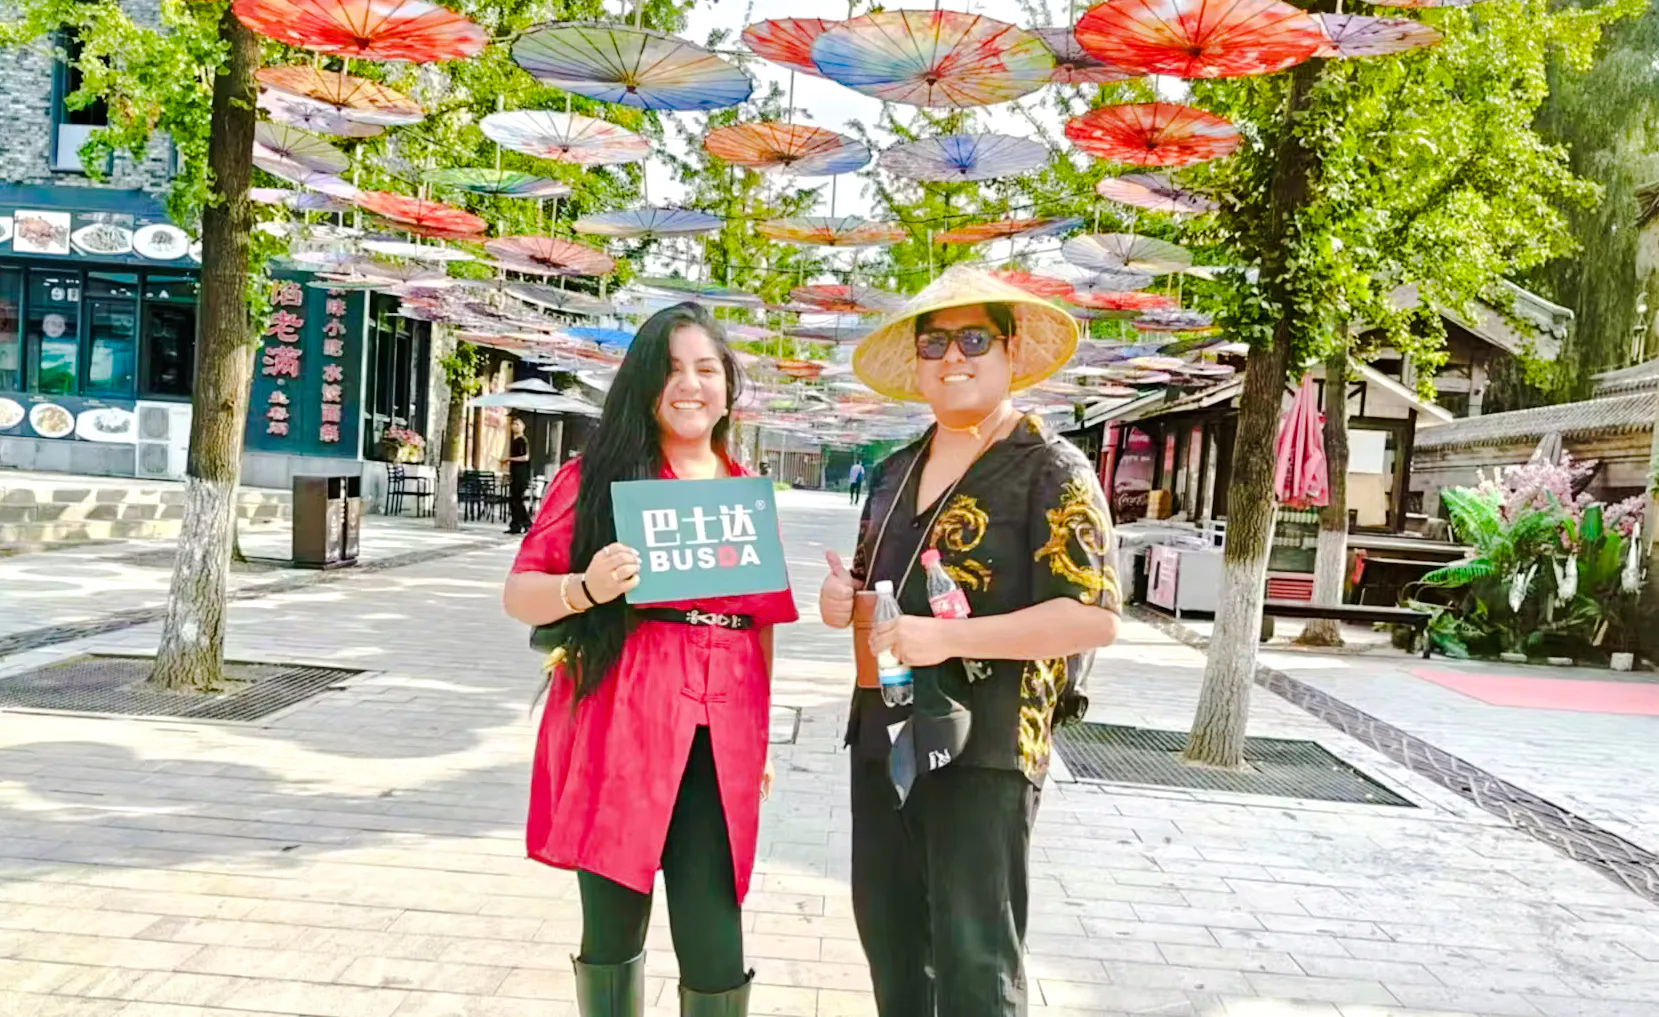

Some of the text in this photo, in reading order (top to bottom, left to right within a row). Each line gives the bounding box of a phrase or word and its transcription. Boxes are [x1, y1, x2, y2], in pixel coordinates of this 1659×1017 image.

[642, 504, 758, 547] 巴士达
[650, 545, 760, 572] BUSDA
